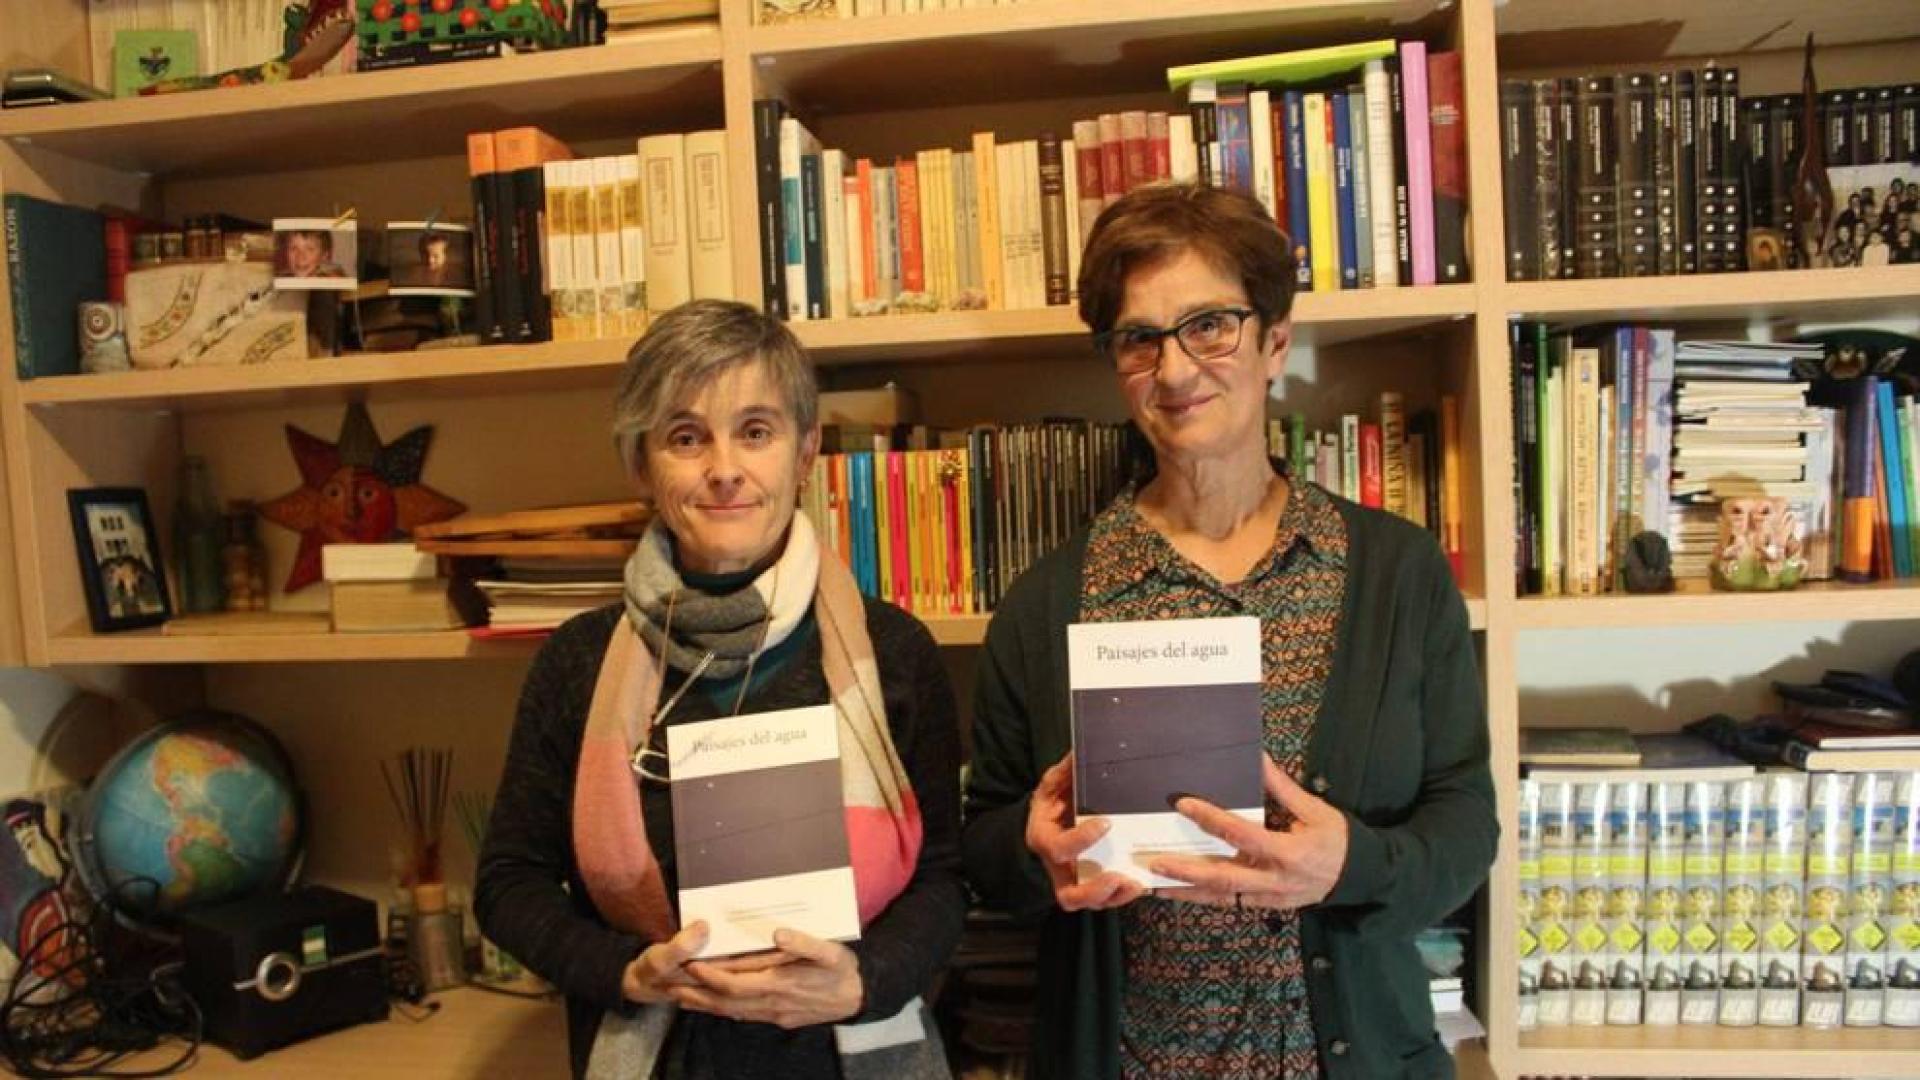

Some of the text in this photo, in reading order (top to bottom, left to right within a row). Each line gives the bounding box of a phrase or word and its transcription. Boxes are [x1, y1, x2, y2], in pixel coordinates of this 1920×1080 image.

[1096, 640, 1229, 664] Paisajes del agua
[749, 729, 773, 746] del
[774, 727, 808, 746] agua
